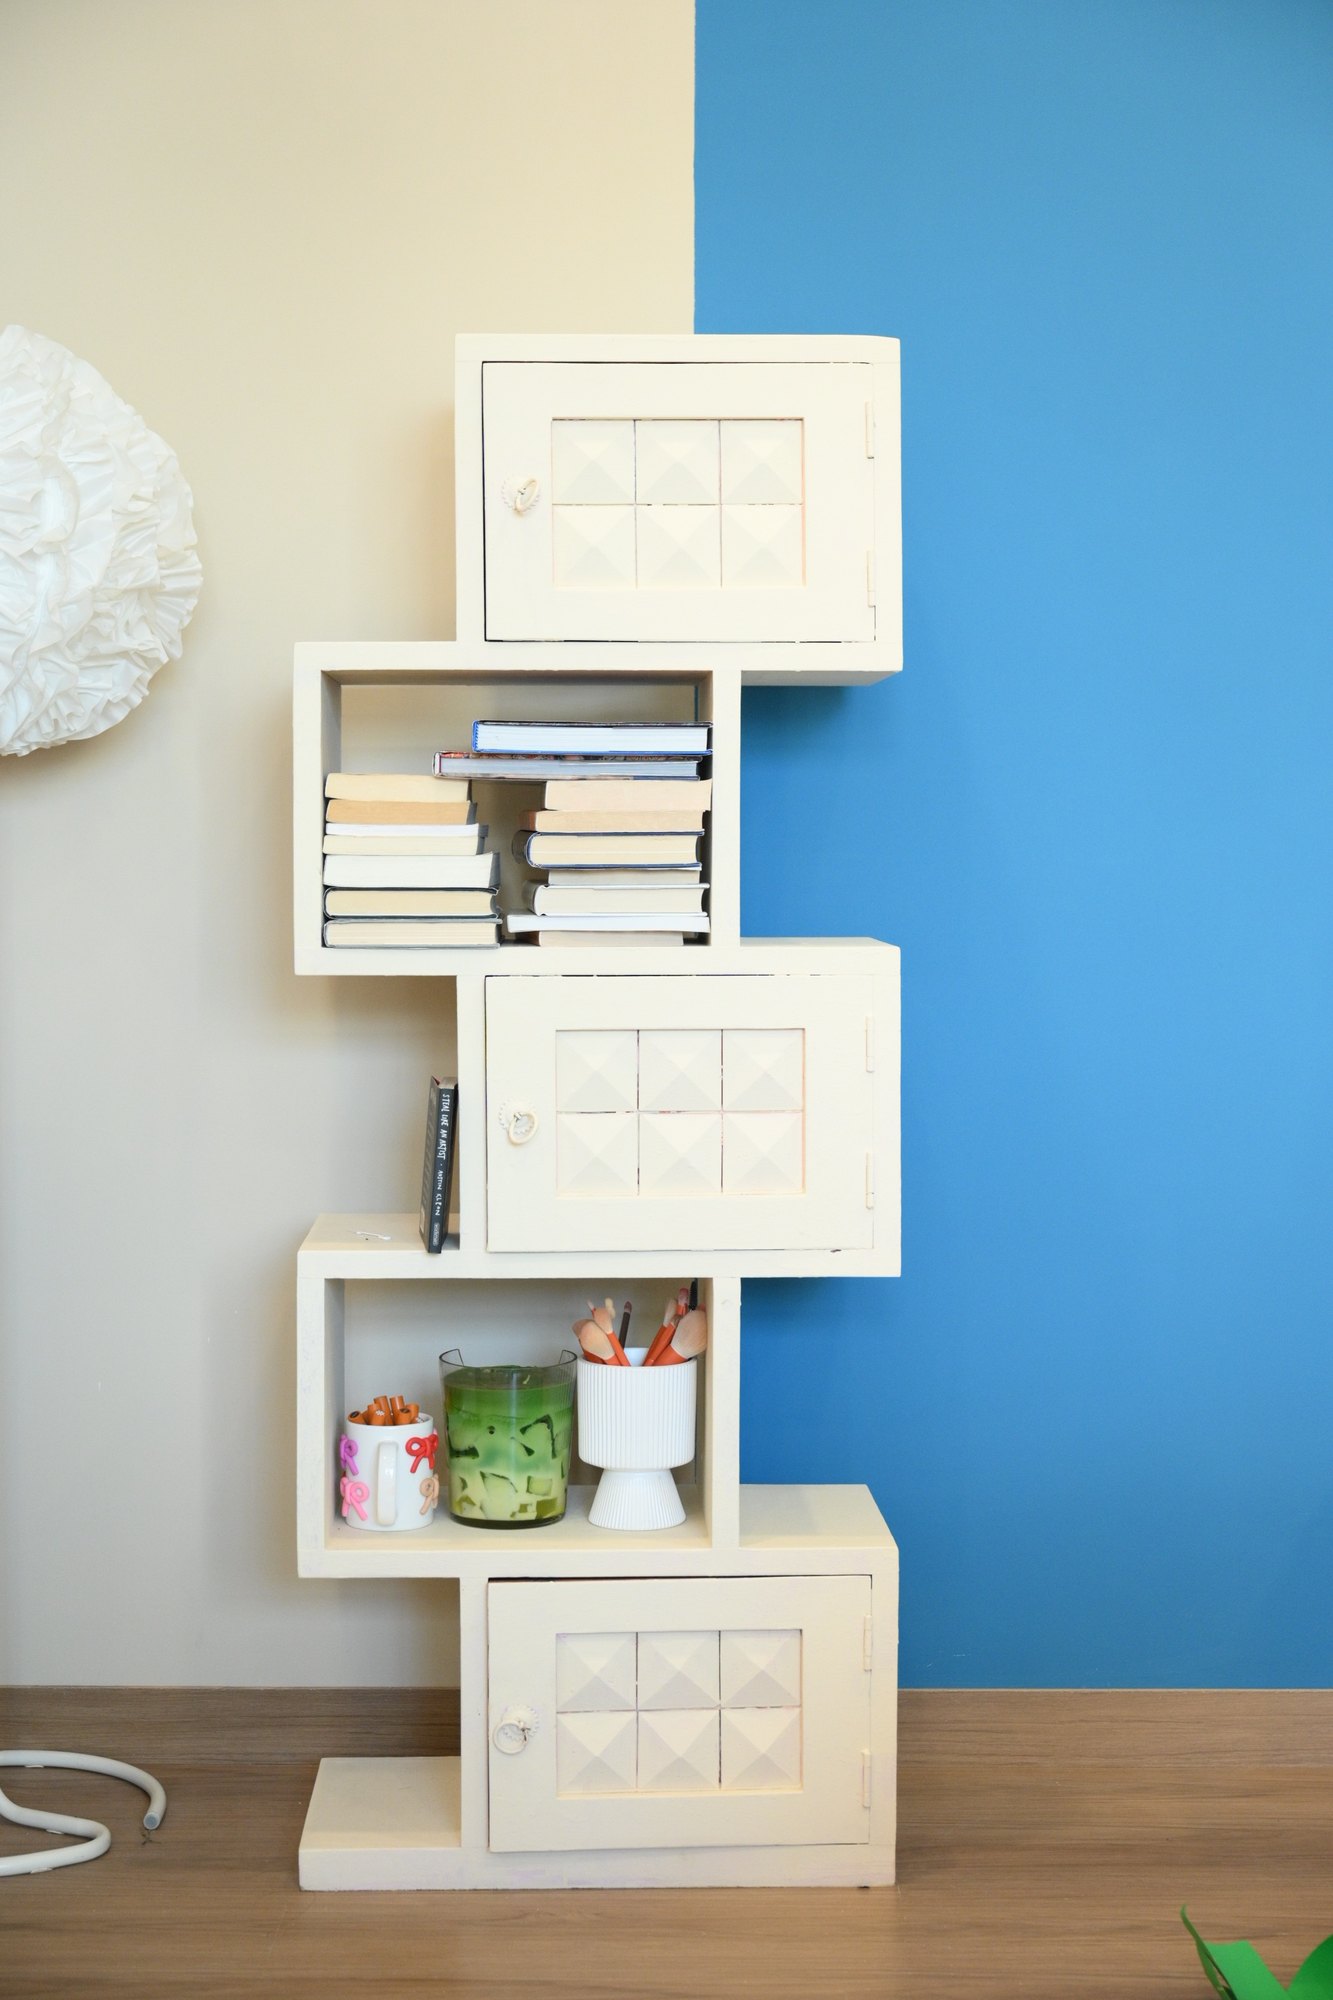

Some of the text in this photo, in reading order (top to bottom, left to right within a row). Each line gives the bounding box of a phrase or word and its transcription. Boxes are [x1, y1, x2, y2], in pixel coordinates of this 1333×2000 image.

[441, 1094, 450, 1111] STEAL
[440, 1129, 447, 1138] AN
[437, 1139, 446, 1160] ARTIST
